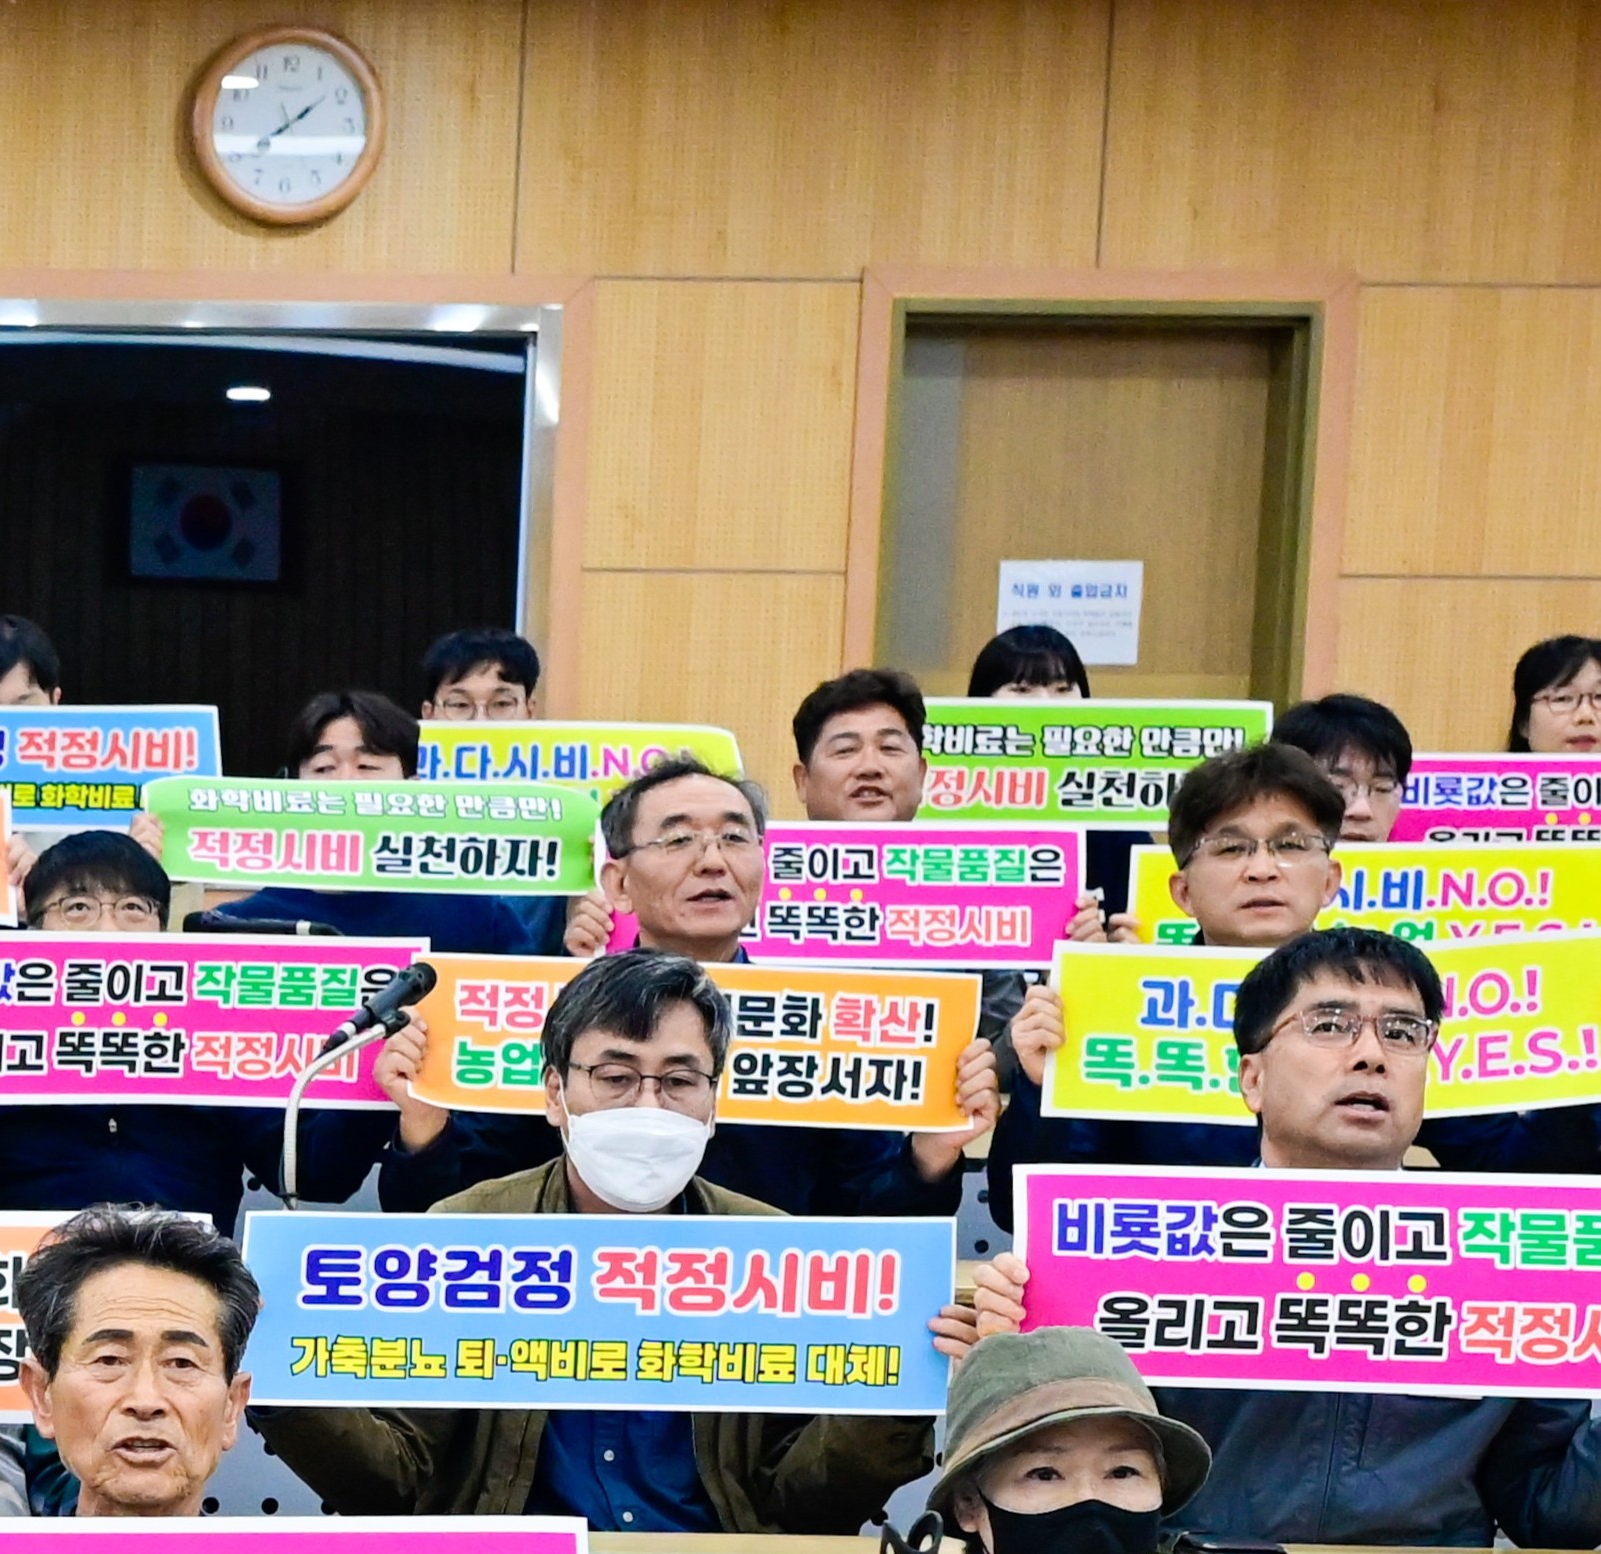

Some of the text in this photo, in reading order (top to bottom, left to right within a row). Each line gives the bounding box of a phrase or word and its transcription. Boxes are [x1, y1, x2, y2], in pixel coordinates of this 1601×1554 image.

[17, 730, 196, 770] 적정시비!
[922, 724, 1034, 757] 학비료는
[1042, 726, 1134, 757] 필요한
[41, 782, 138, 810] 화학비료
[187, 788, 562, 821] 화학비료는 필요한 만큼만!
[927, 770, 1045, 807] 정시비
[189, 830, 558, 878] 적정시비 실천하자!
[771, 845, 1063, 883] 줄이고 작물품질은
[768, 905, 880, 942] 똑똑한
[889, 910, 1030, 945] 적정시비
[65, 964, 186, 1004] 줄이고
[833, 998, 934, 1045] 확산!
[56, 1030, 186, 1074] 똑똑한
[732, 1054, 921, 1101] 앞장서자!
[1057, 1202, 1272, 1259] 비룟값은
[1285, 1207, 1449, 1262] 줄이고
[301, 1248, 896, 1317] 토양검정 적정시비!
[1098, 1296, 1259, 1352] 올리고
[1275, 1297, 1451, 1357] 똑똑한
[290, 1336, 448, 1379] 가축분뇨
[636, 1341, 797, 1384] 화학비료
[806, 1344, 900, 1386] 대체!
